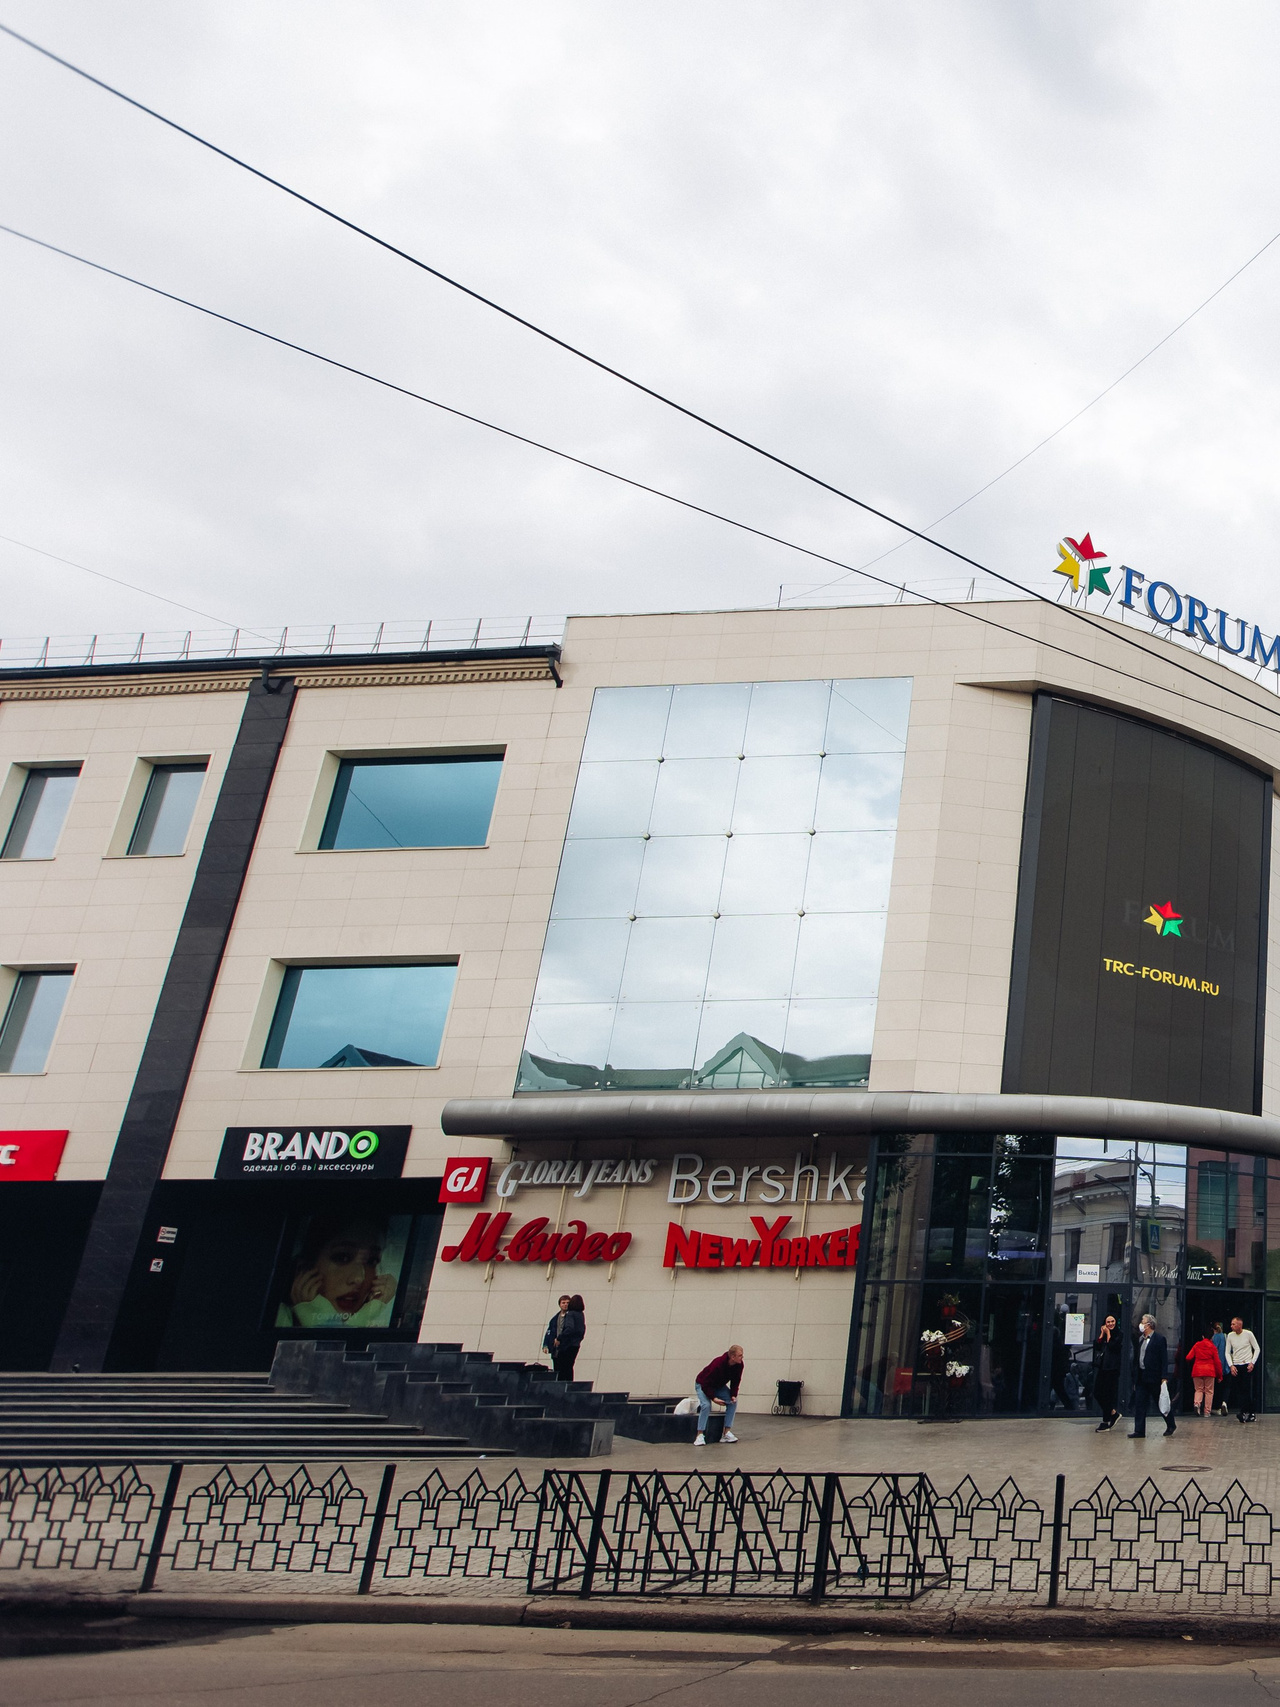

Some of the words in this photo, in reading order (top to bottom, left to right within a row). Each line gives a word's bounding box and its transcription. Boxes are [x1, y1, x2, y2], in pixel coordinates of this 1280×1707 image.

[1103, 958, 1220, 996] TRC-FORUM.RU
[242, 1130, 380, 1161] BRANDO
[243, 1164, 278, 1172] одежда
[284, 1163, 312, 1171] обвь
[318, 1163, 374, 1172] аксессуары
[446, 1166, 483, 1193] GJ
[496, 1160, 584, 1197] GLORIA
[573, 1159, 658, 1198] JEANS
[1078, 1269, 1098, 1277] Выход
